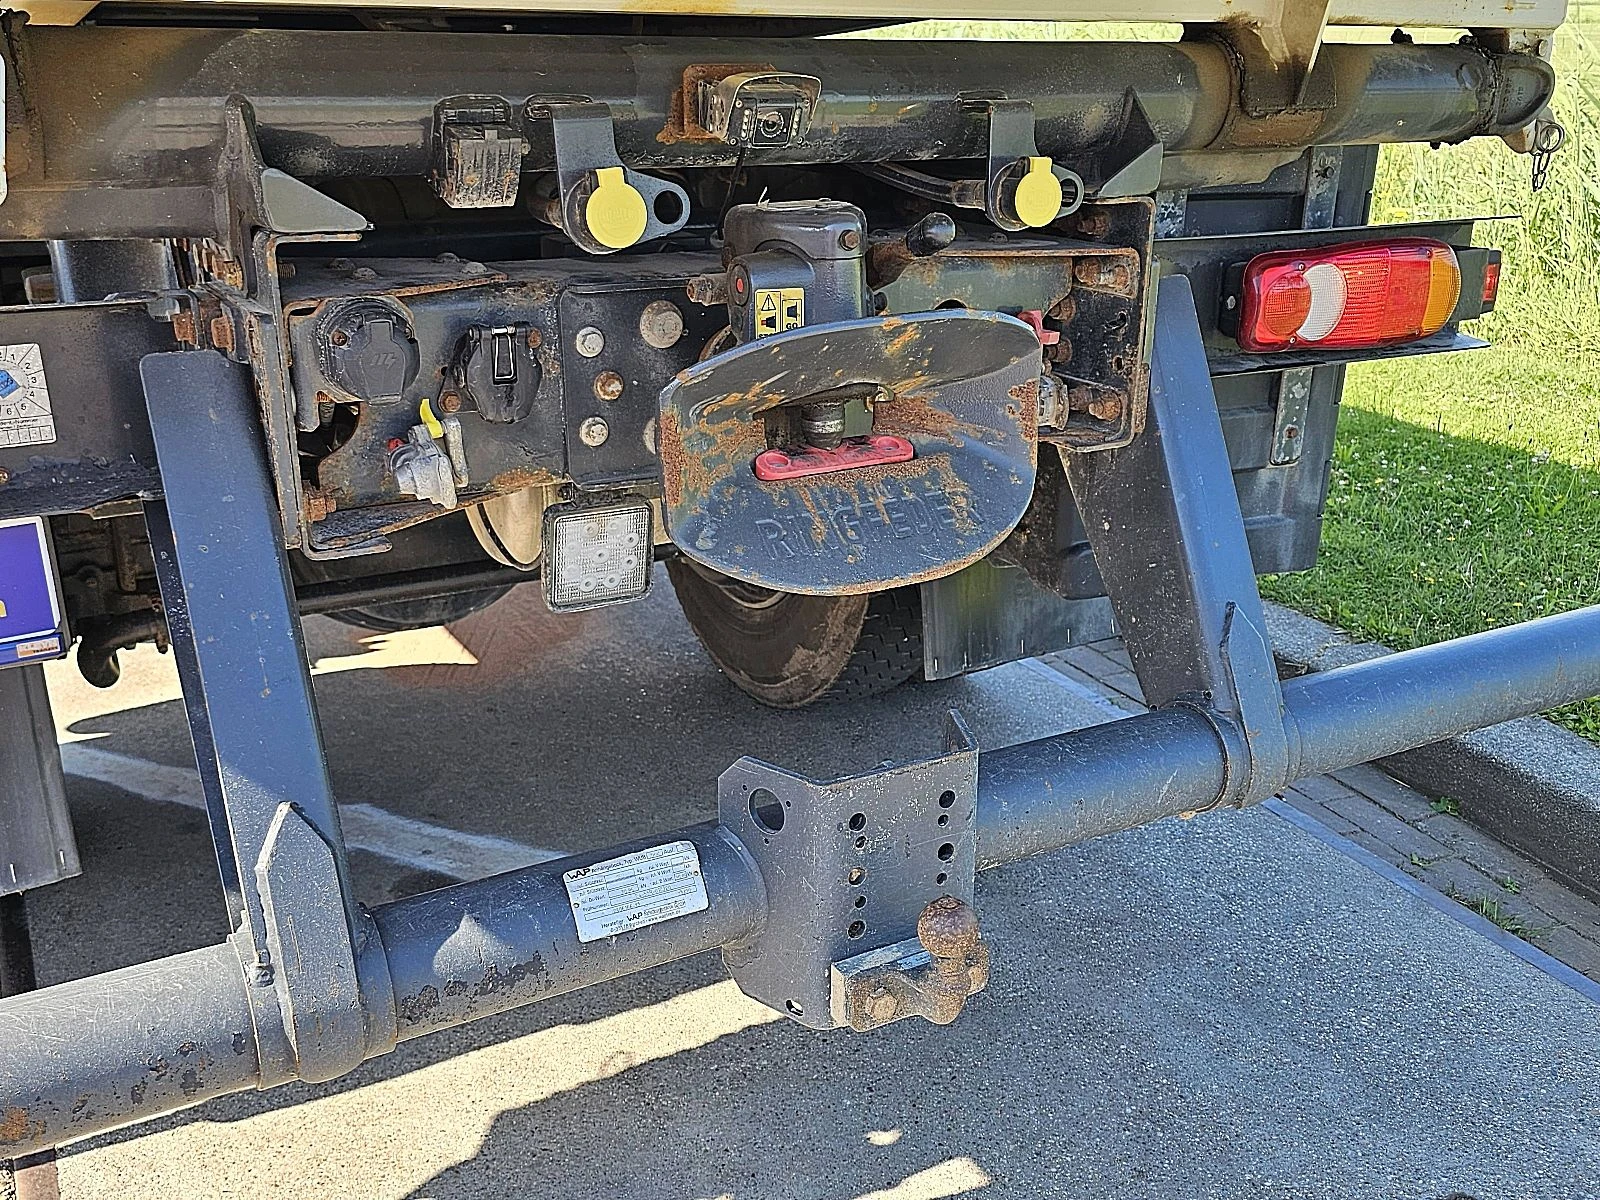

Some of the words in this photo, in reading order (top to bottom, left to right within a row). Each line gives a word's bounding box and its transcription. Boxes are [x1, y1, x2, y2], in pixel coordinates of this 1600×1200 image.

[20, 403, 27, 411] 5
[6, 408, 12, 416] 6
[567, 868, 591, 880] WAP
[627, 911, 643, 921] WAP
